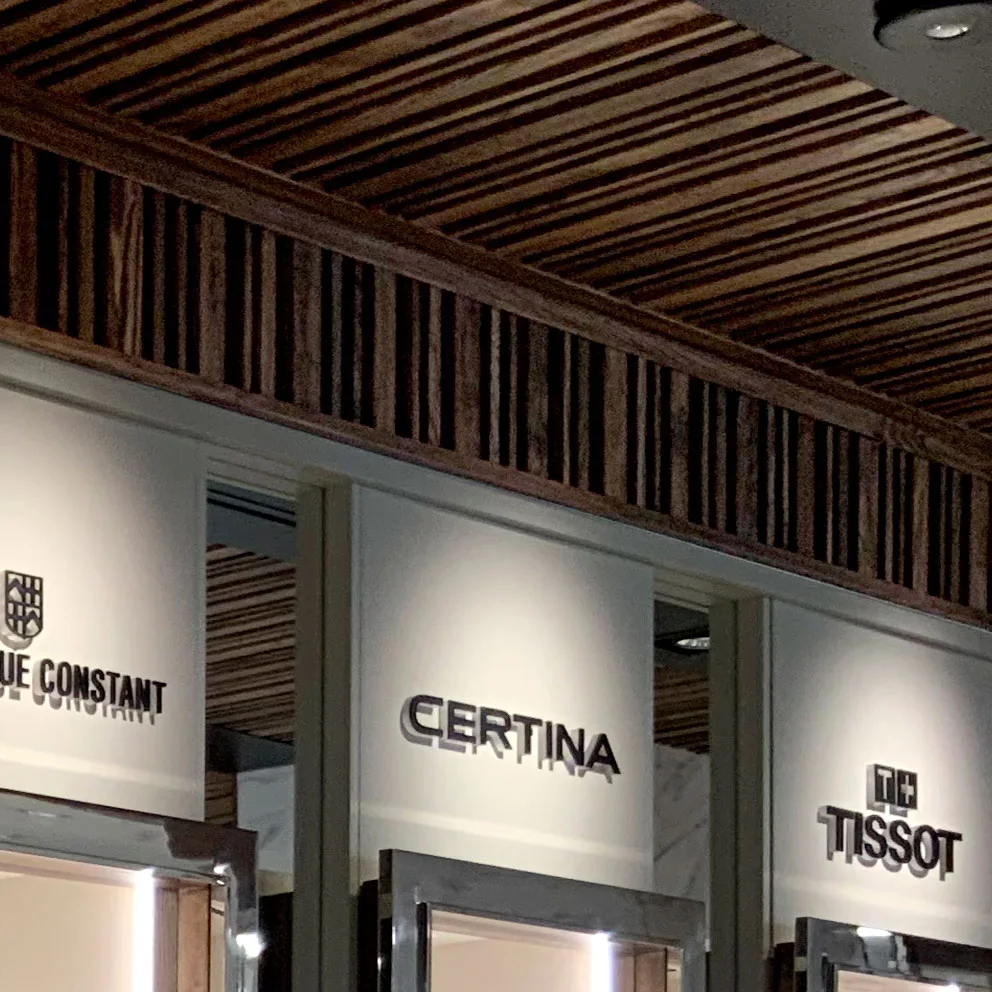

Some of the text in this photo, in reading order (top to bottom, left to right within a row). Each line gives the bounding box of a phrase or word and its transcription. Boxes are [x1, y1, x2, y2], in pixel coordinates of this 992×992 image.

[40, 658, 167, 714] CONSTANT
[408, 694, 621, 775] CERTINA
[826, 805, 963, 873] TISSOT
